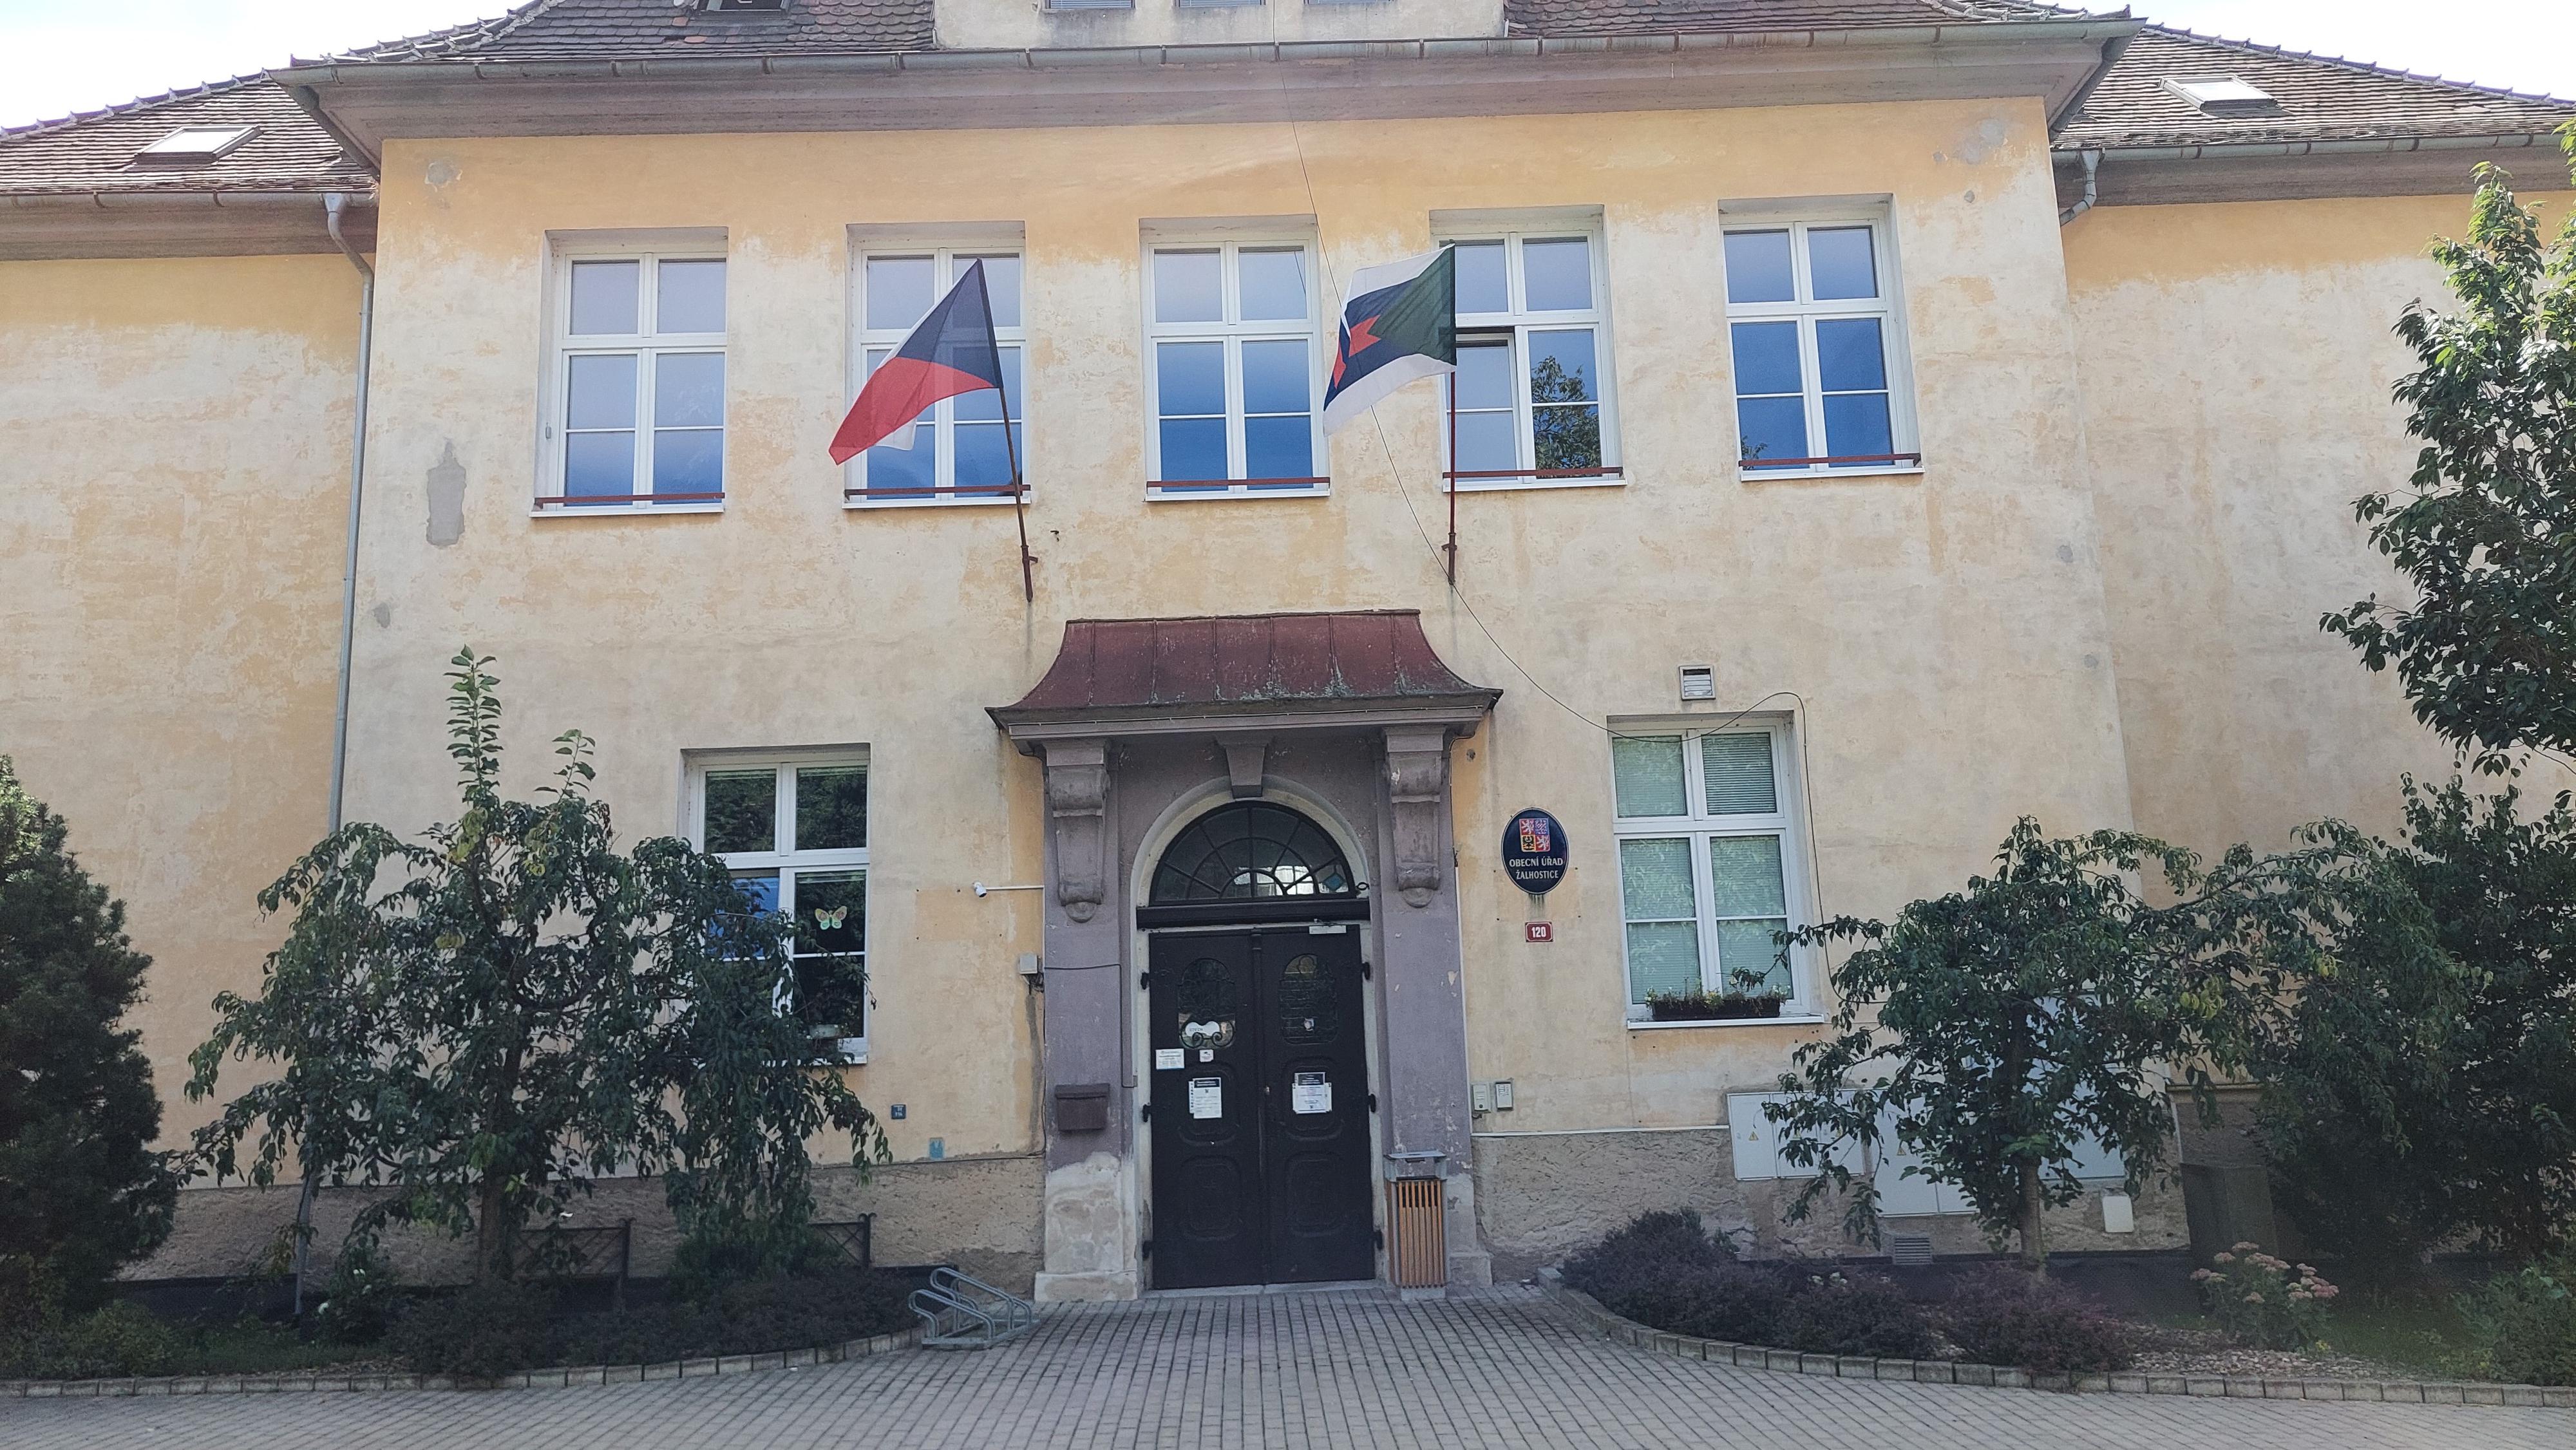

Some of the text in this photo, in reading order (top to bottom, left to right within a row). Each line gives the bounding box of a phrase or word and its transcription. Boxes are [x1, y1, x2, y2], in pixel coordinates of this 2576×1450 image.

[1509, 856, 1564, 867] OBECNÍ ÚŘAD
[1515, 869, 1559, 880] ŽALHOSTICE
[1531, 926, 1547, 938] 120
